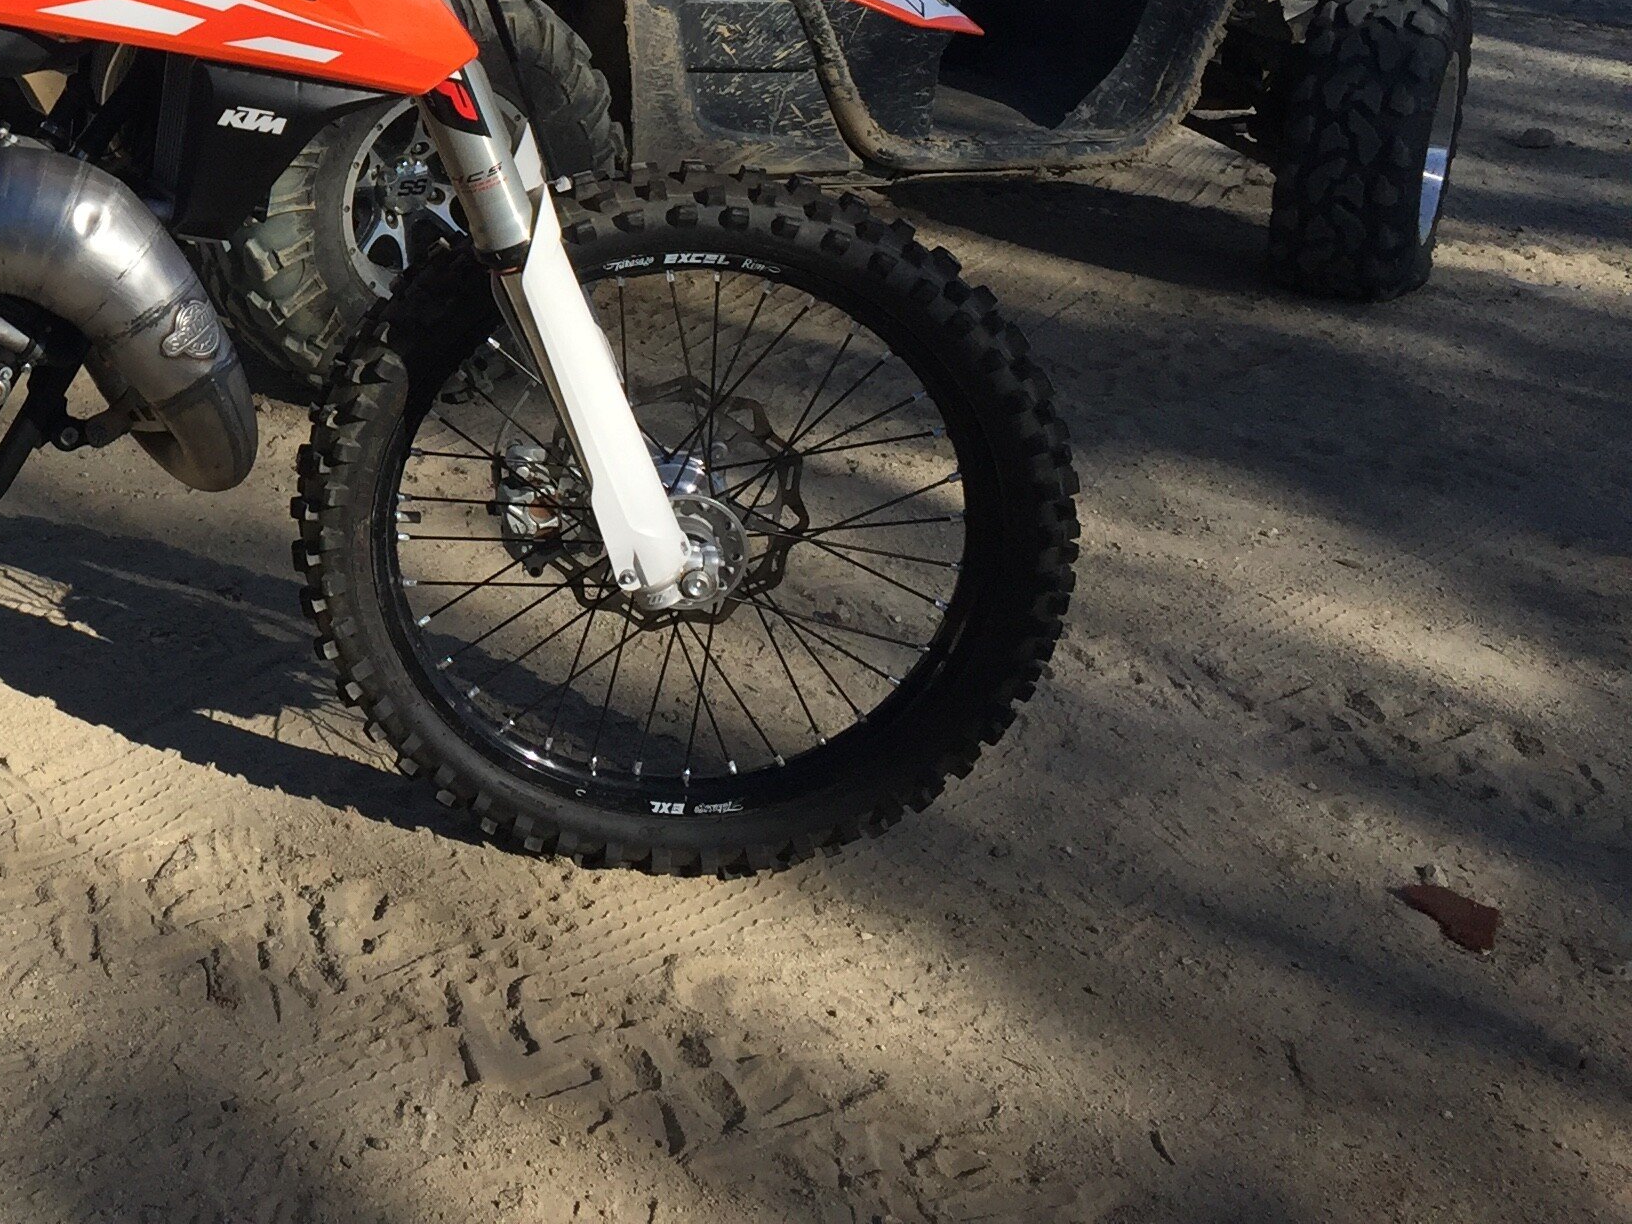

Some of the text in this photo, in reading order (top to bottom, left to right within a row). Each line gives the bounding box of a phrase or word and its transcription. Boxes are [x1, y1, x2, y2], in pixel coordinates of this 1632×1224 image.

[217, 106, 287, 135] KTM
[663, 253, 730, 265] EXCEL
[740, 258, 766, 272] Rim
